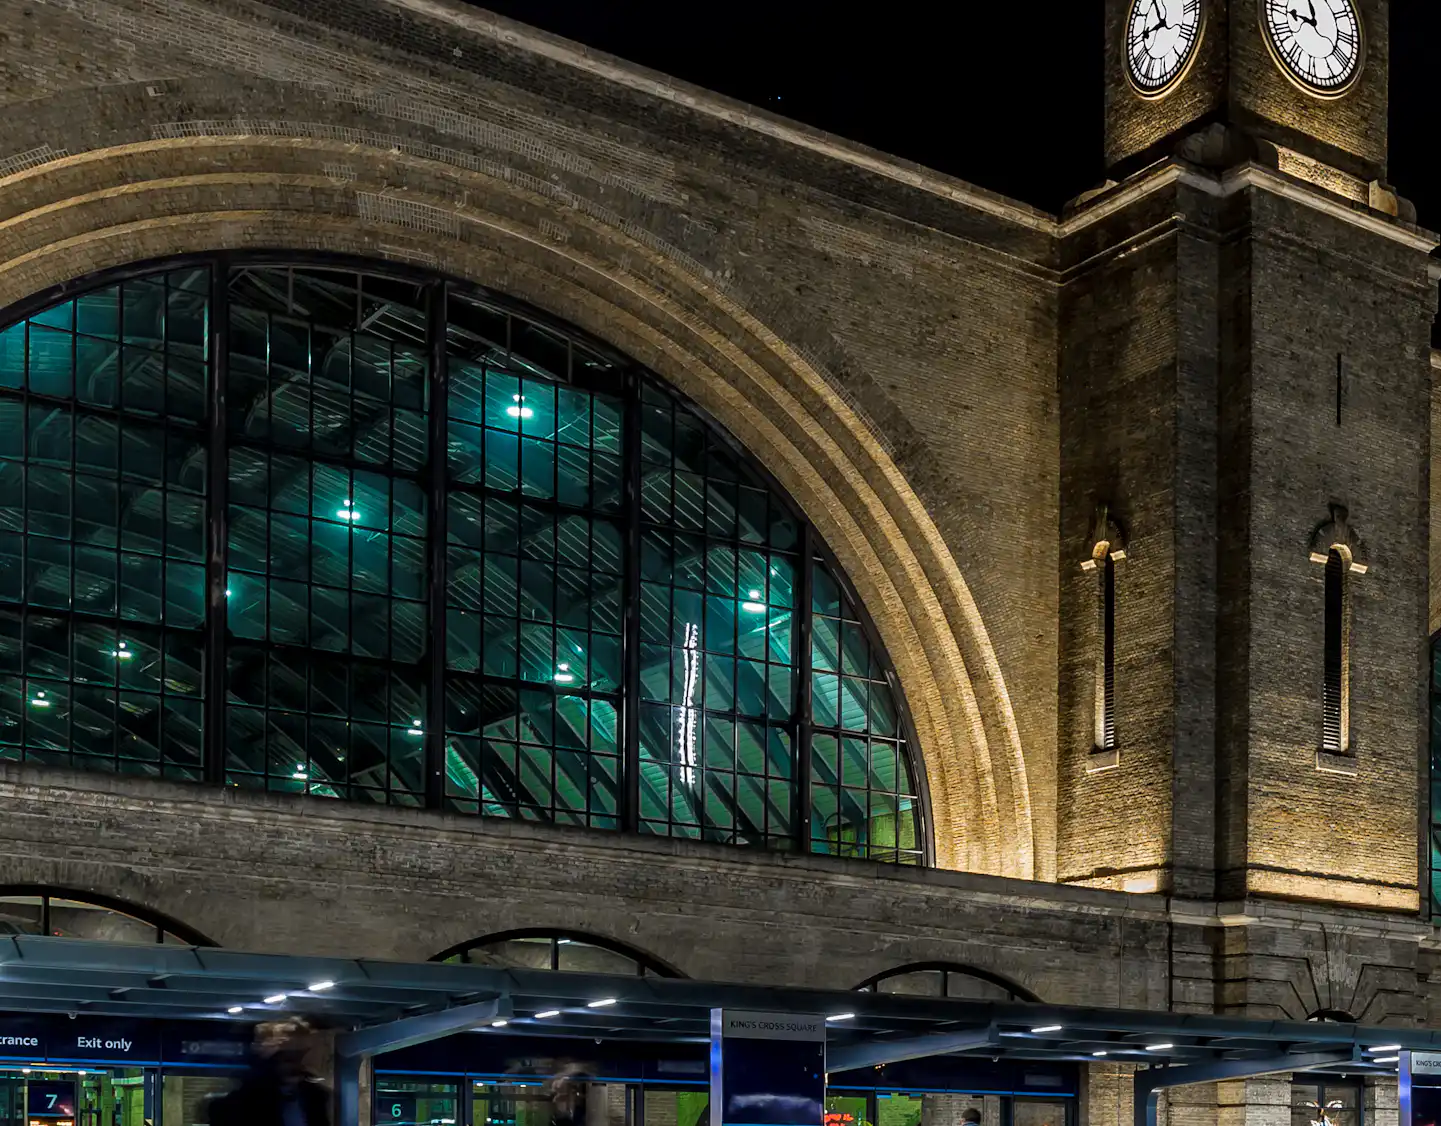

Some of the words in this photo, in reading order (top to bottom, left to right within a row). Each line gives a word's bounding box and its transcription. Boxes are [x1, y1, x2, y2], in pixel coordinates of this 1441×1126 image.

[730, 1020, 756, 1029] KING'S
[758, 1022, 785, 1030] CROSS
[786, 1023, 817, 1032] SQUARE
[77, 1036, 102, 1049] Exit
[105, 1038, 132, 1052] only
[45, 1093, 58, 1109] 7
[391, 1103, 402, 1118] 6
